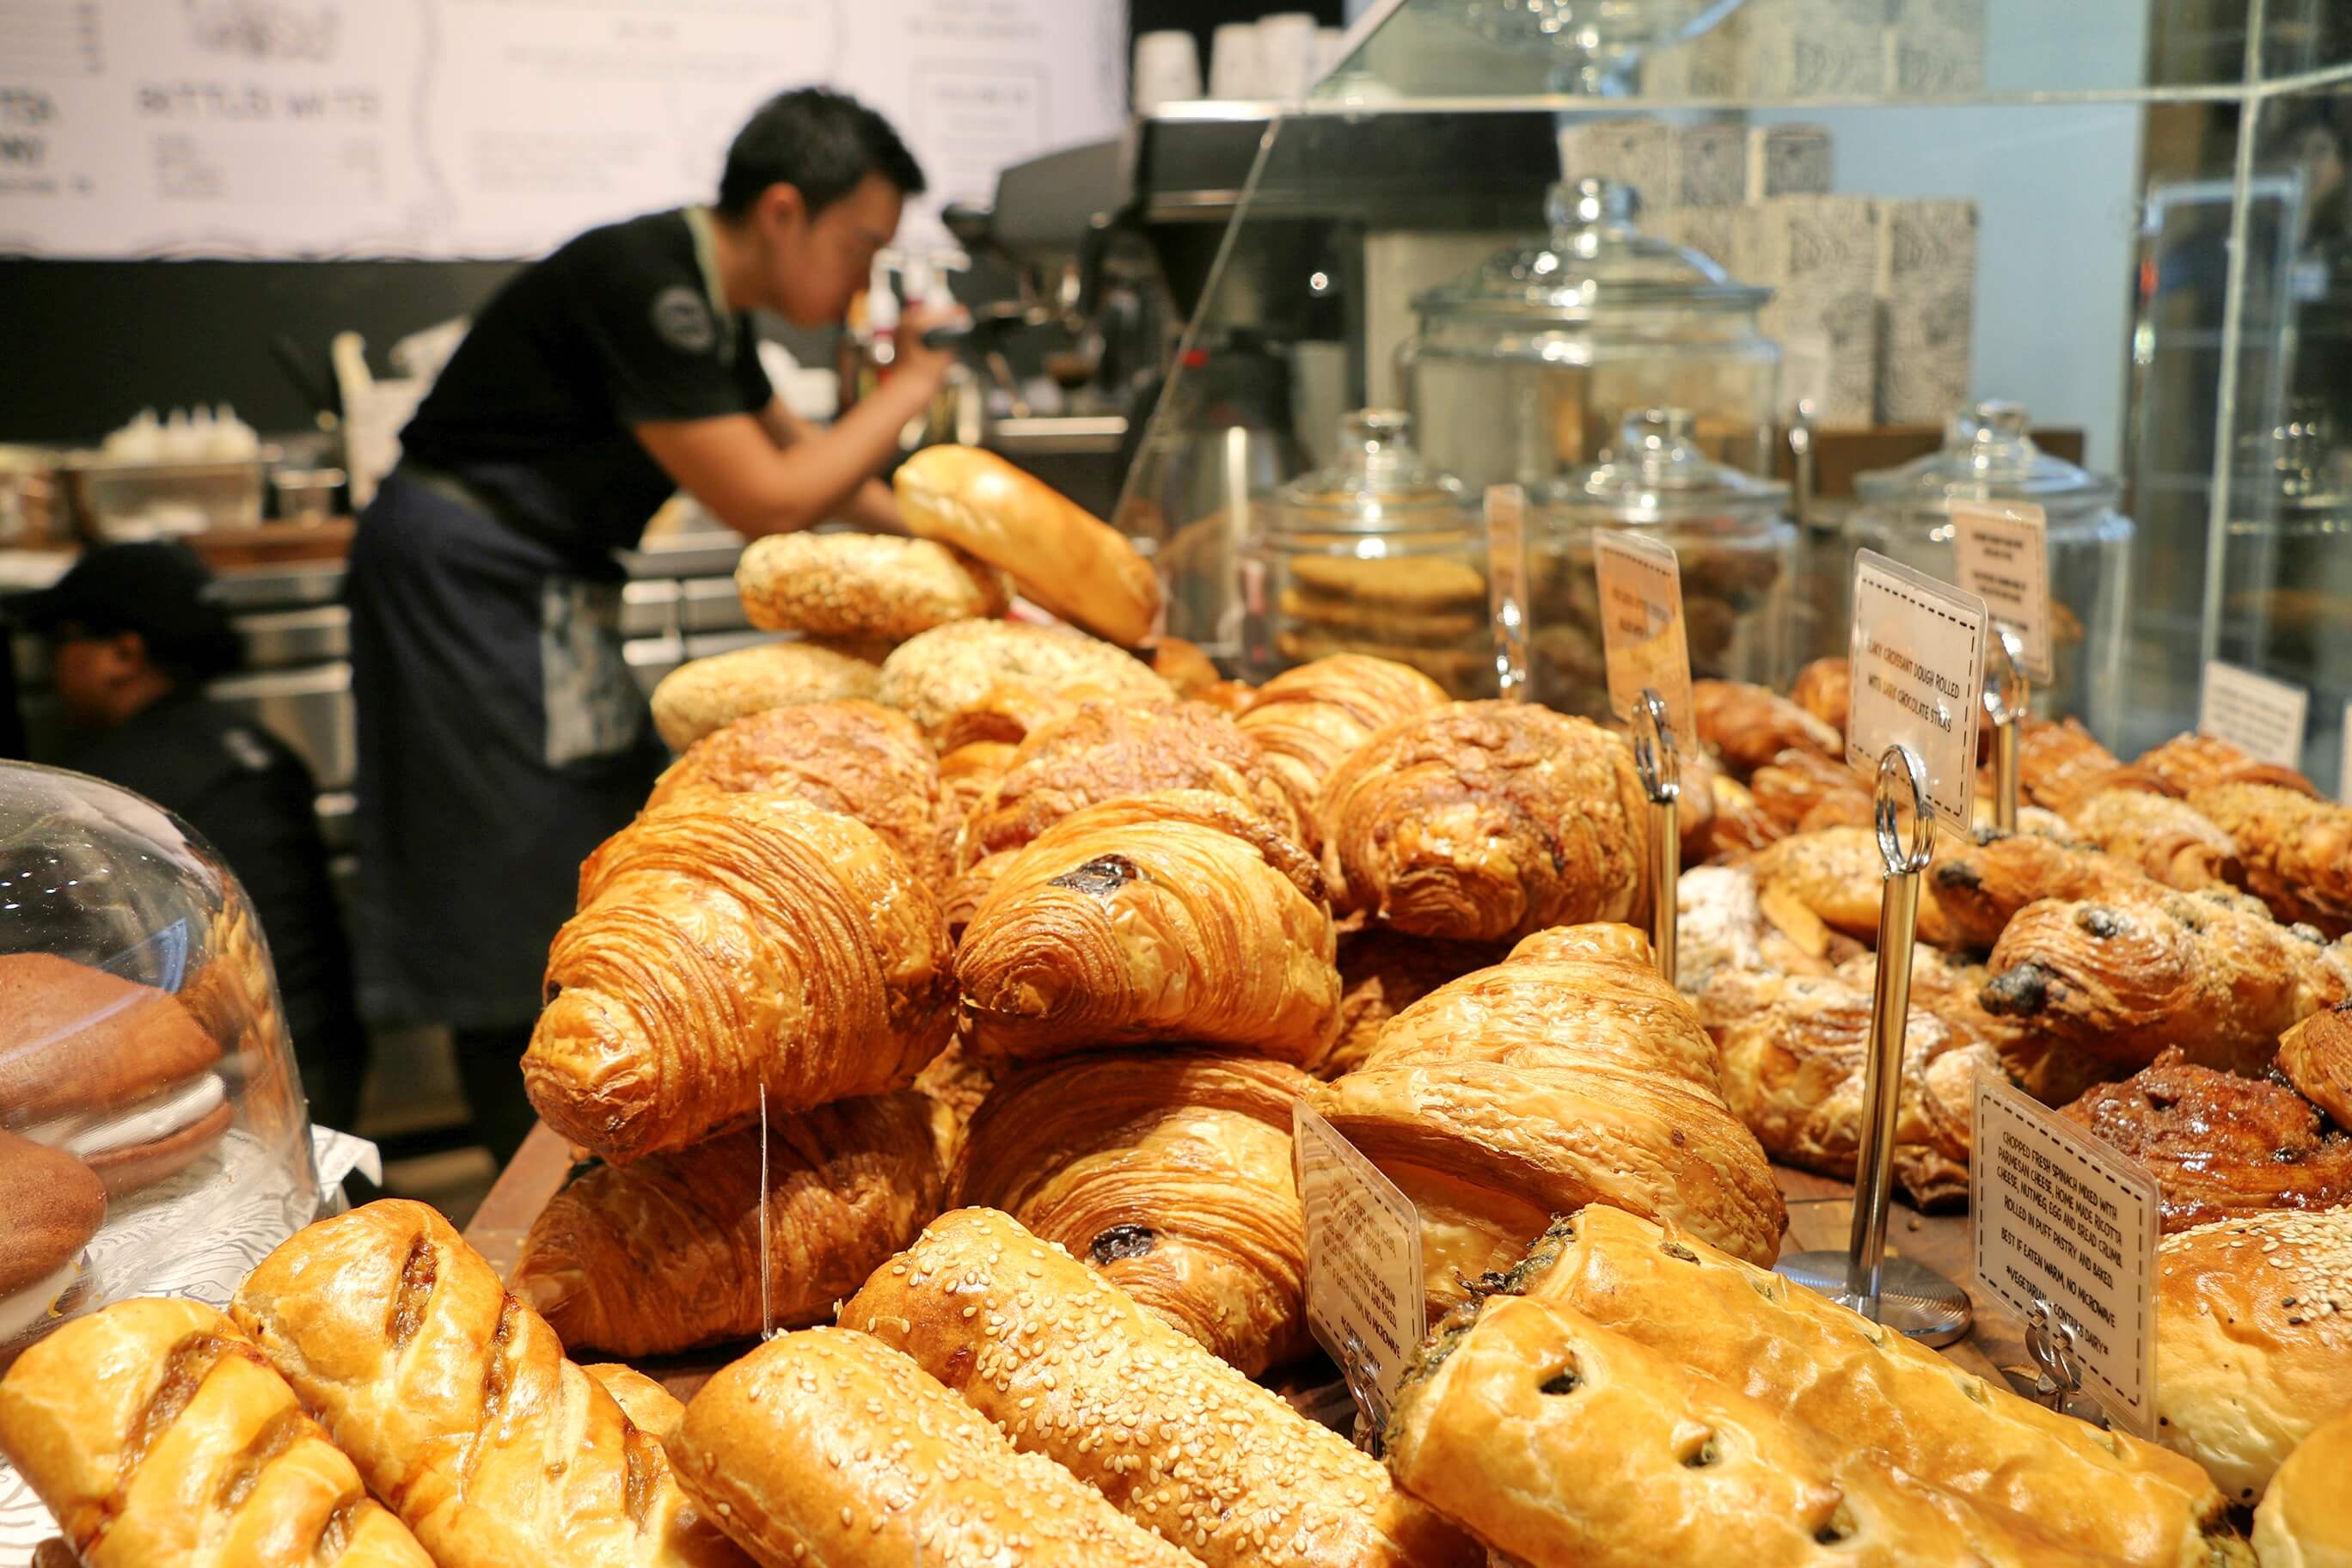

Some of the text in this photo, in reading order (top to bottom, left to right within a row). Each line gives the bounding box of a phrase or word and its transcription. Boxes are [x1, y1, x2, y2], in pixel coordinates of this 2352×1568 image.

[1897, 689, 1928, 719] CHOCOLATE
[1914, 663, 1934, 687] DOUGH
[1934, 675, 1959, 700] ROLLED
[1997, 1165, 2018, 1192] CHEESE,
[2020, 1182, 2048, 1214] NUTMEG,
[2049, 1202, 2061, 1221] EGG
[2062, 1212, 2075, 1232] AND
[2077, 1223, 2096, 1247] BREAD
[1998, 1147, 2122, 1245] PARMESAN CHEESE, HOME MADE RICOTTA
[2002, 1130, 2116, 1221] CHOPPED FRESH SPINACH MIXED WITH
[2004, 1196, 2026, 1222] ROLLED
[2028, 1213, 2034, 1227] IN
[2036, 1219, 2051, 1240] PUFF
[2053, 1232, 2077, 1260] PASTRY
[2079, 1252, 2090, 1271] AND
[1371, 1289, 1380, 1310] AND
[2001, 1227, 2115, 1328] BEST IF EATEN WARM, NO MICROWAVE
[1364, 1308, 1370, 1324] NO
[1372, 1316, 1400, 1359] MICROWAVE
